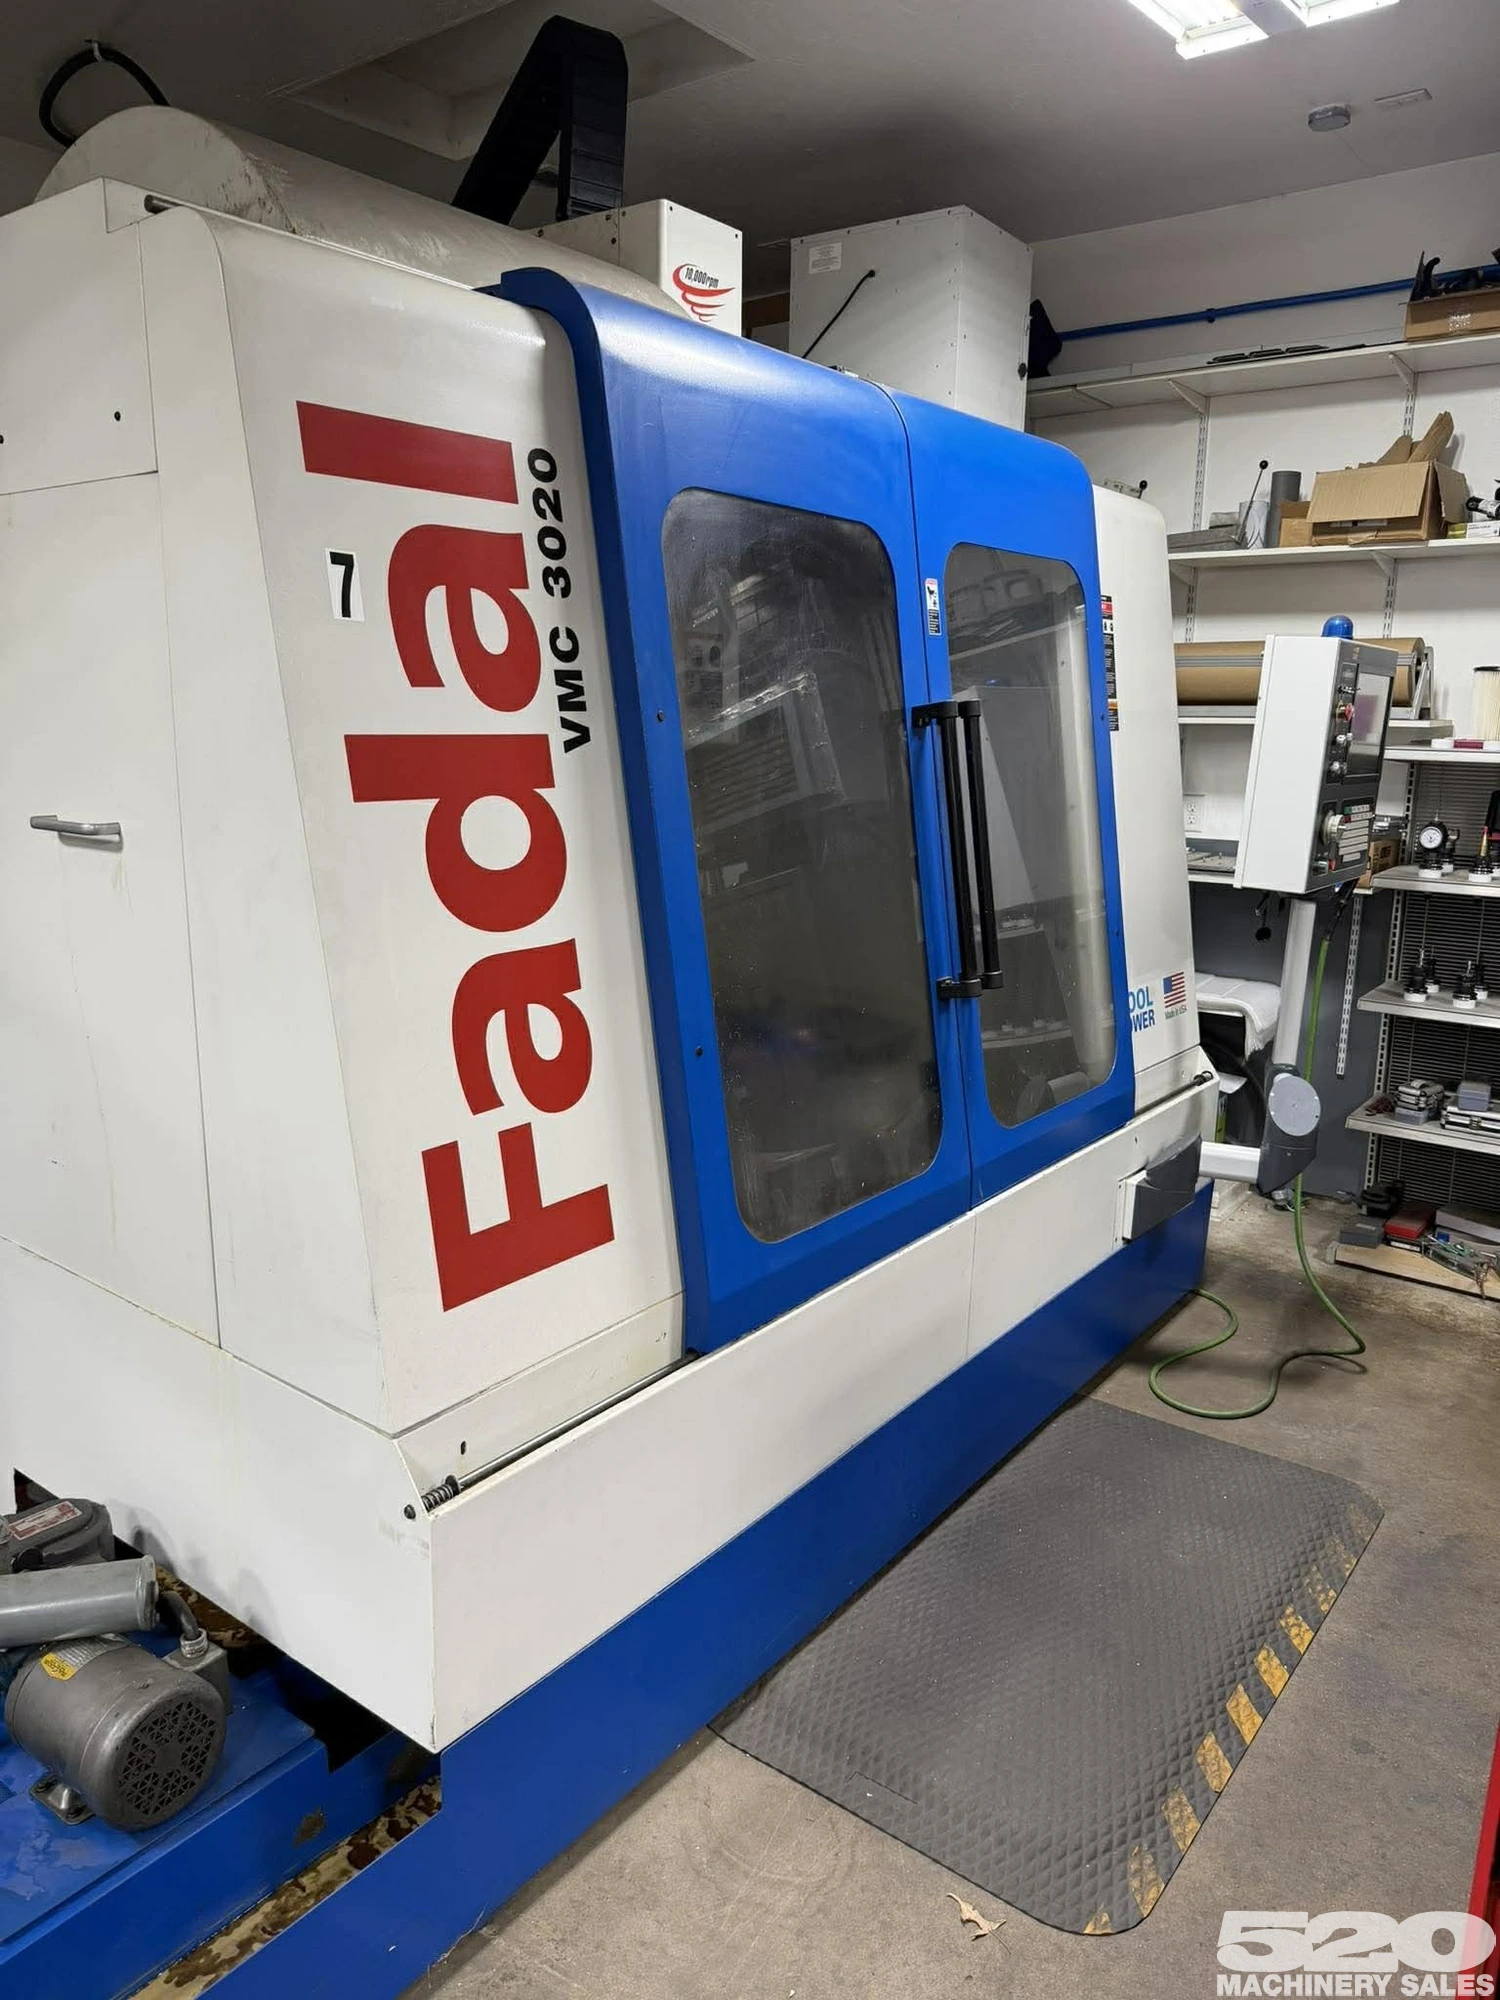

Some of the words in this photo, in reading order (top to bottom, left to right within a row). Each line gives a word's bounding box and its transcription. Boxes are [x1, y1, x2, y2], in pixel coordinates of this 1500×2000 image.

[685, 267, 719, 288] 10,000rpm
[527, 448, 571, 599] 3020
[329, 551, 354, 619] 7
[549, 626, 591, 754] VMC
[296, 400, 615, 1312] Fadal
[1128, 986, 1153, 1013] OOL
[1131, 1009, 1155, 1032] WER
